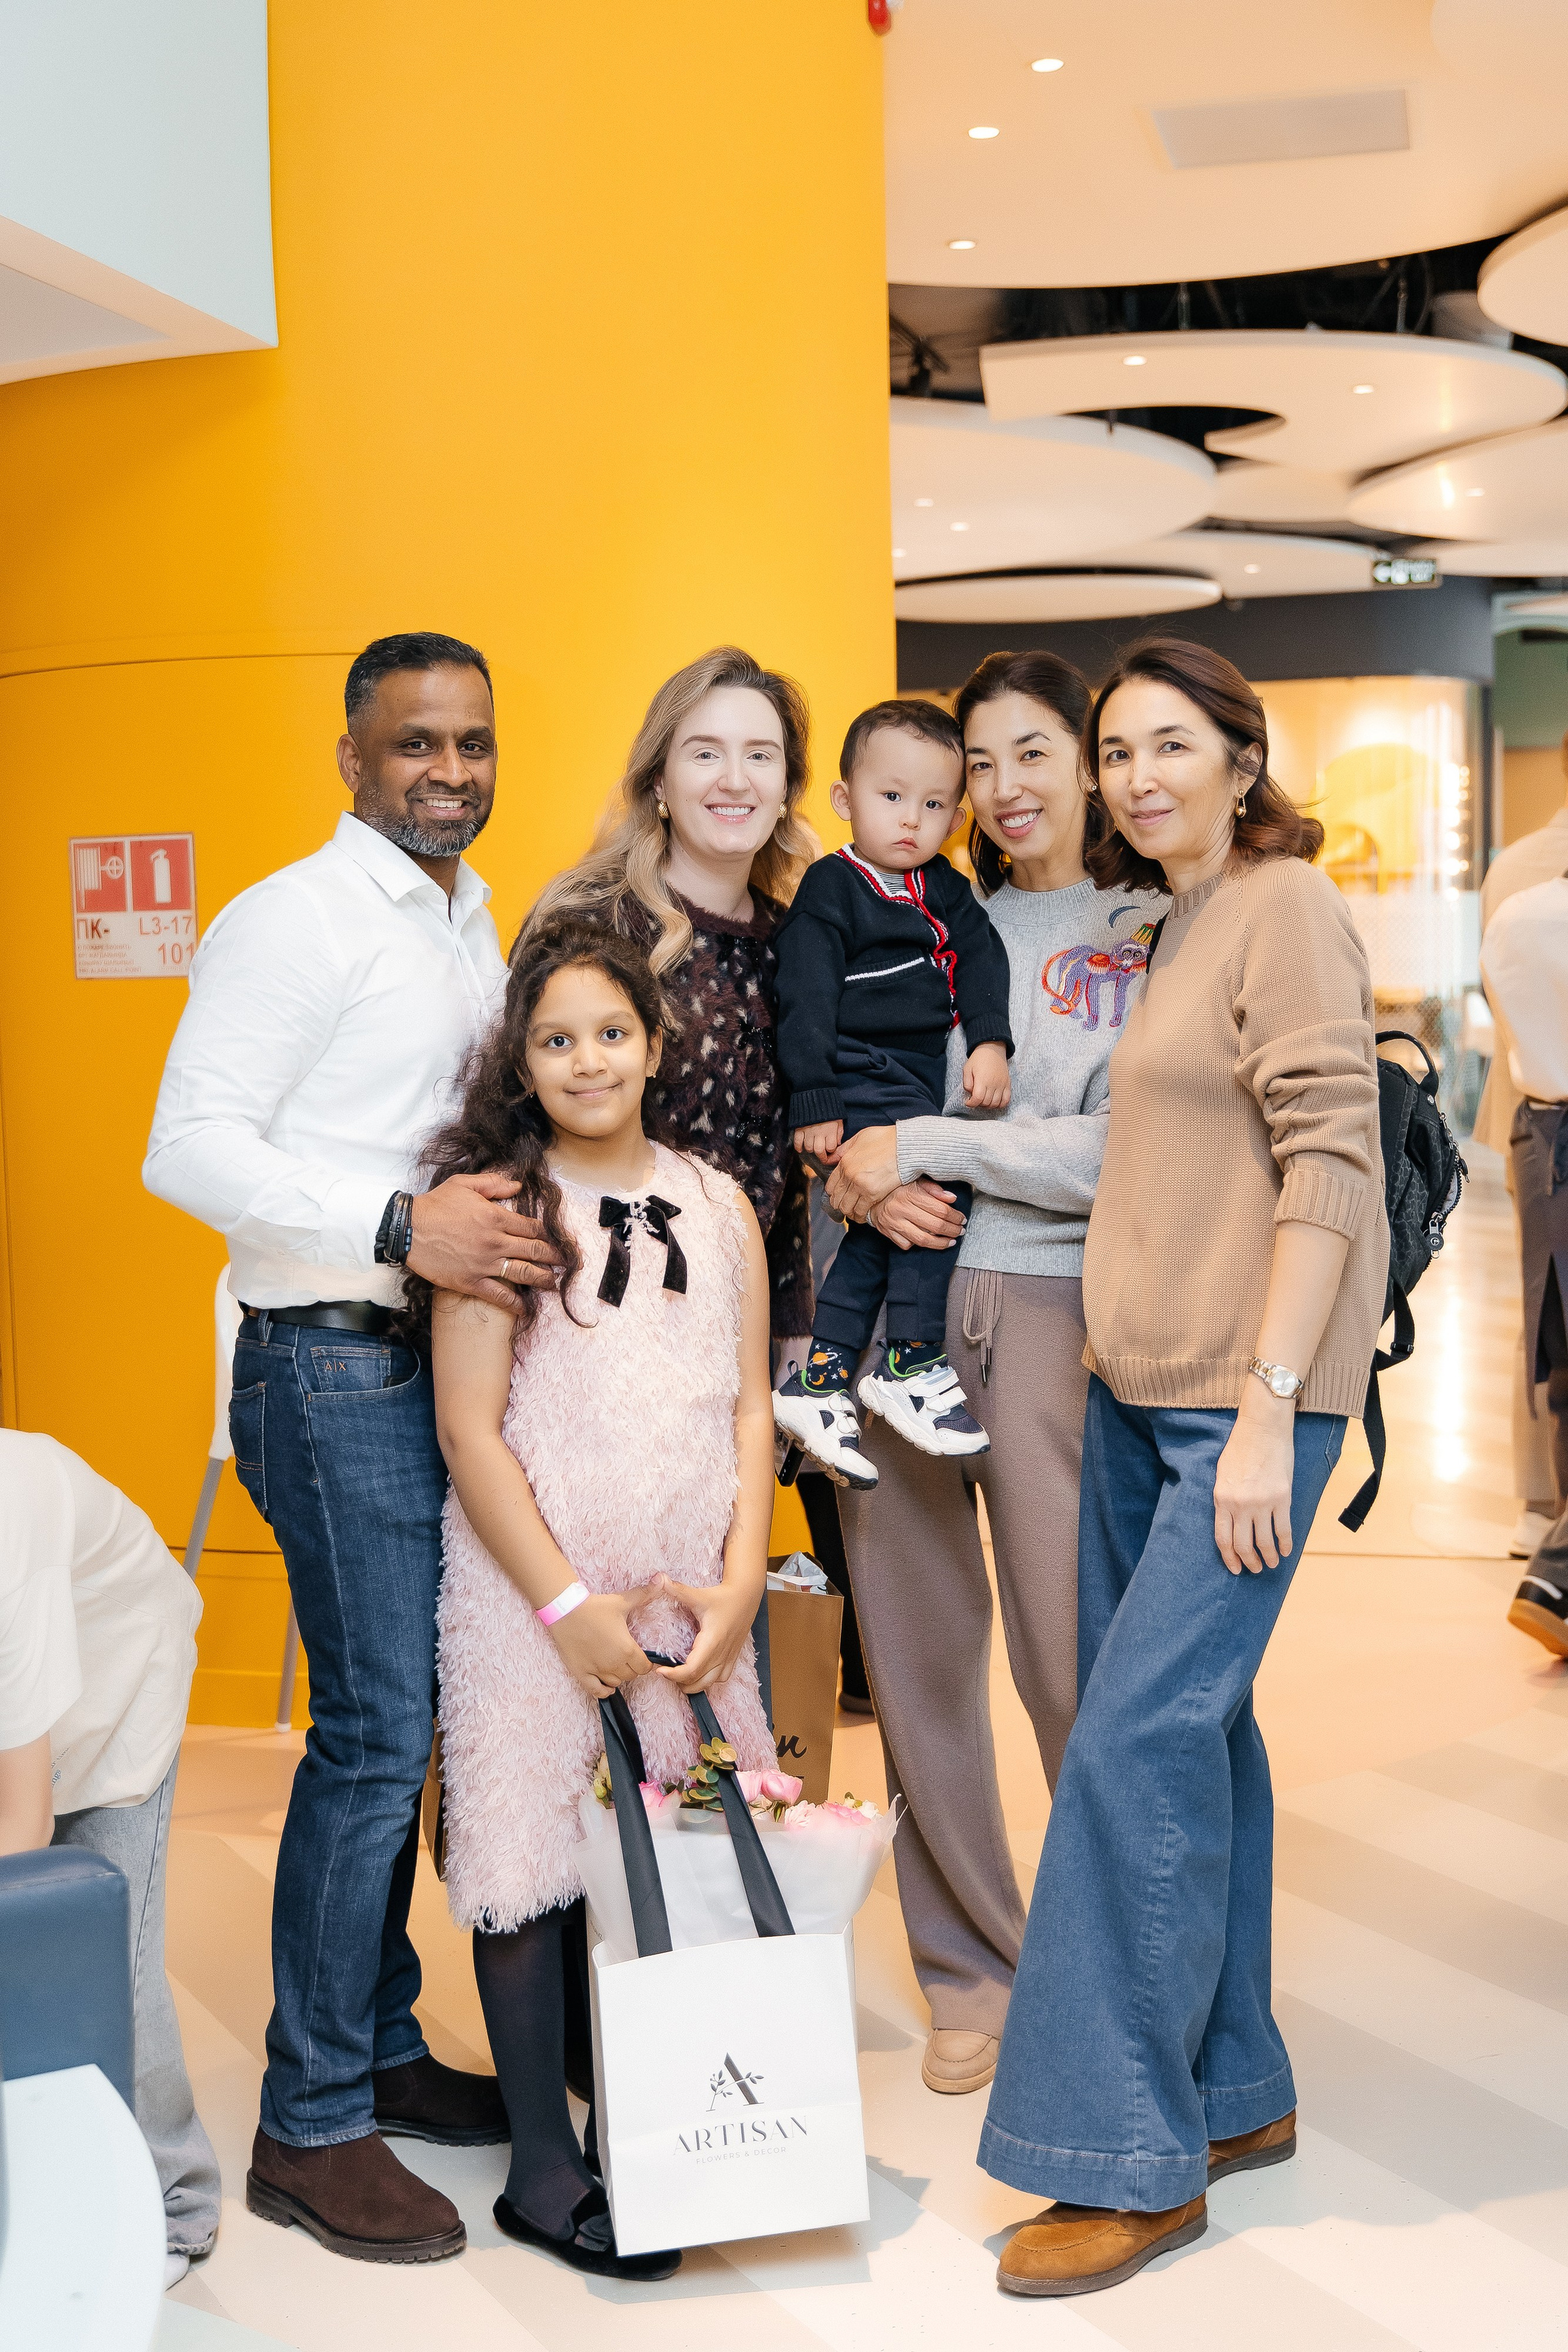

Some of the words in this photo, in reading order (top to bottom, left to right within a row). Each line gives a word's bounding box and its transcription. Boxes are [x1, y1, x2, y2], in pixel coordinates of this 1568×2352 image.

[139, 916, 193, 935] L3-17
[158, 943, 194, 965] 101
[673, 2116, 807, 2155] ARTISAN
[696, 2152, 740, 2165] FLOWERS
[754, 2146, 786, 2156] DECOR
